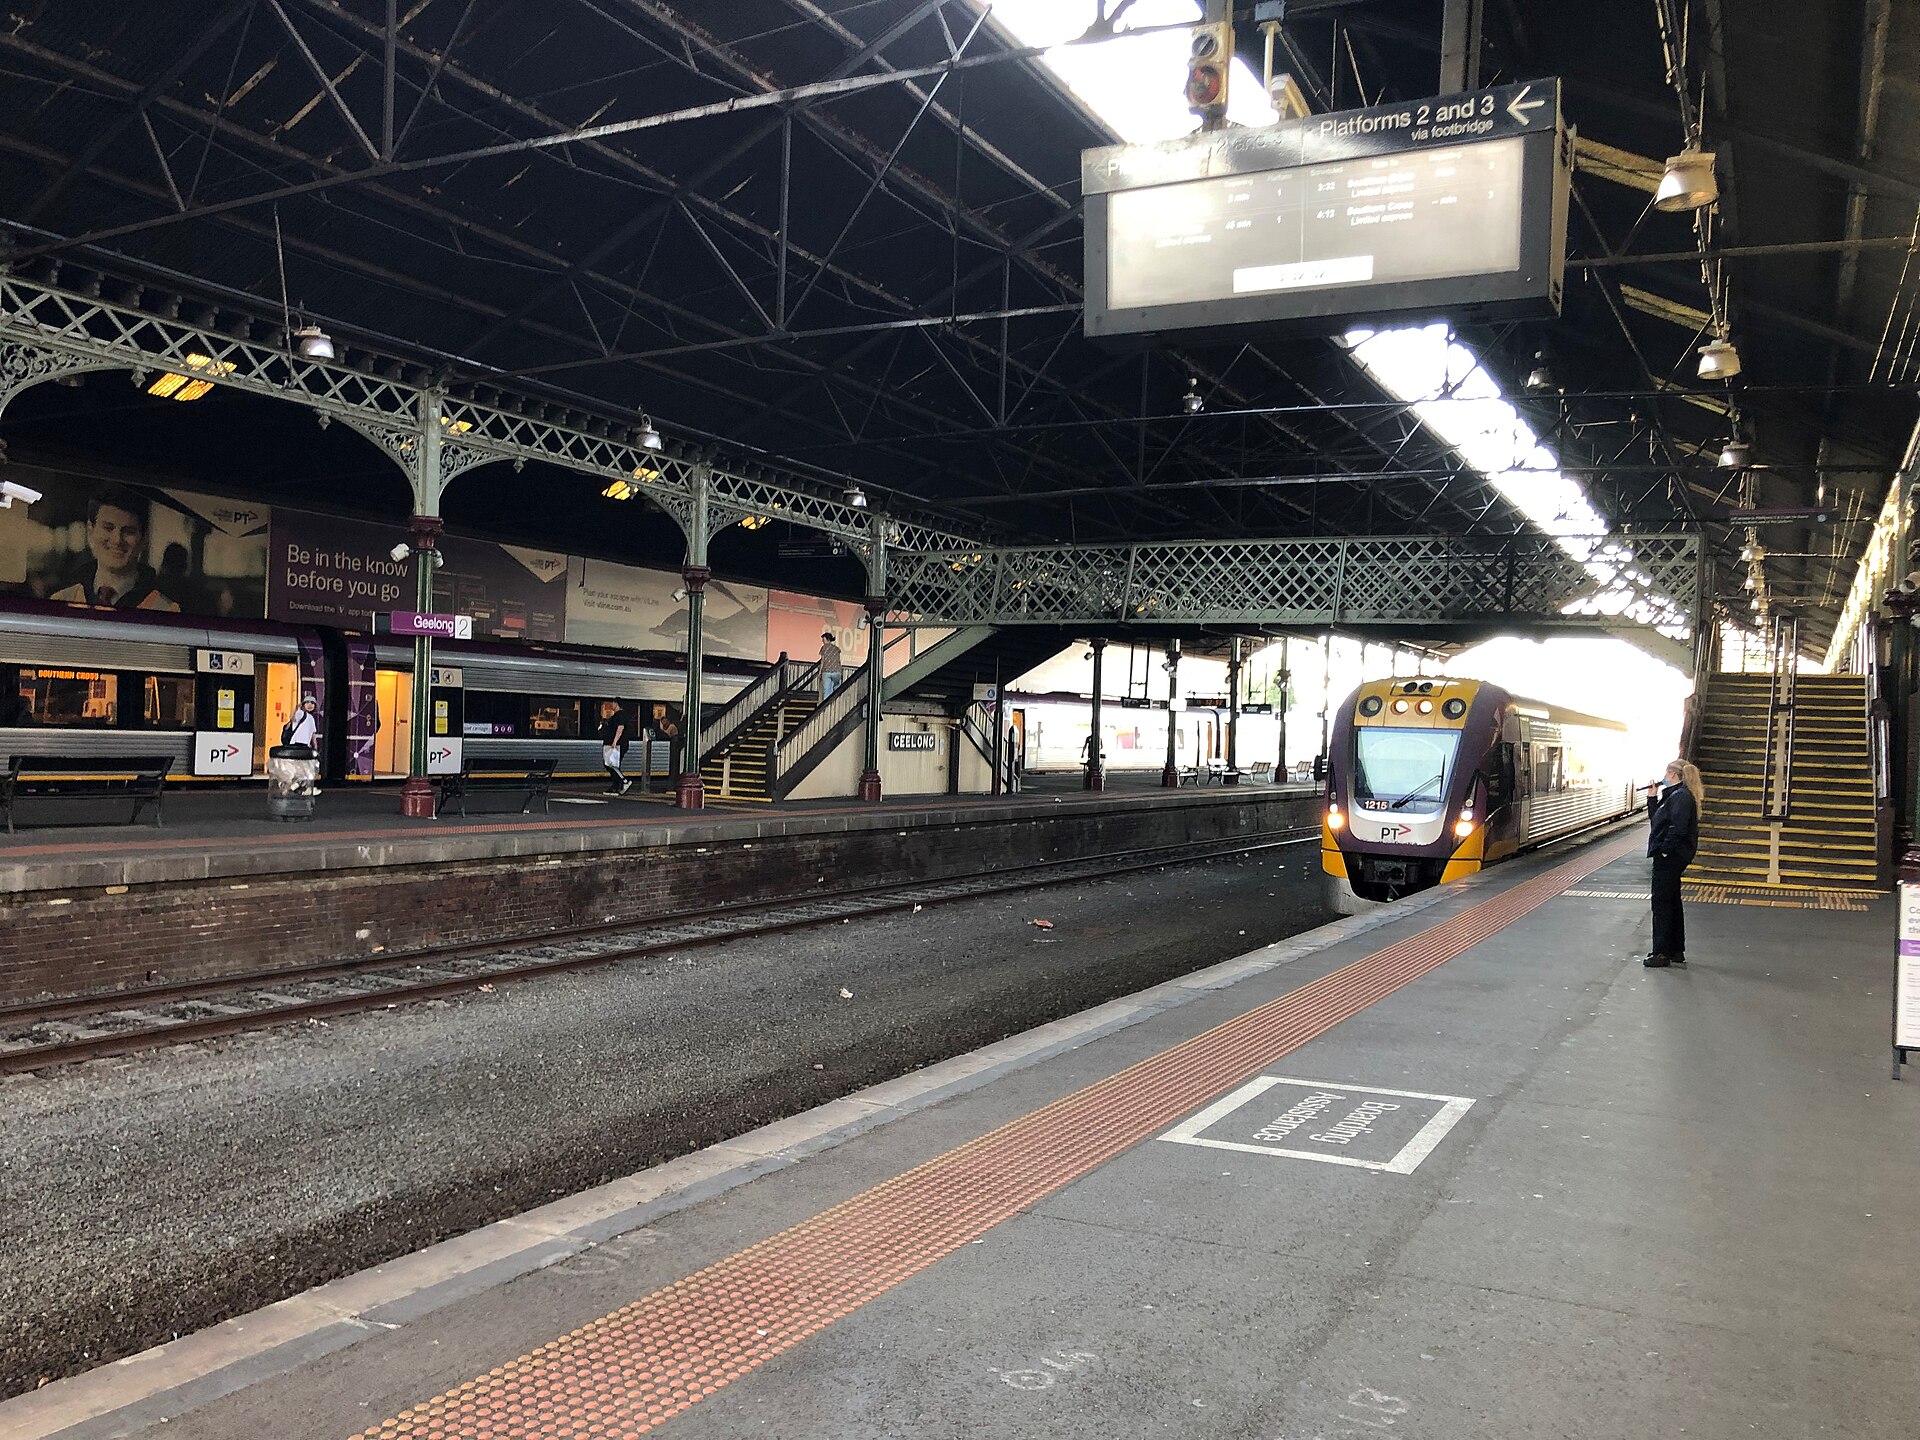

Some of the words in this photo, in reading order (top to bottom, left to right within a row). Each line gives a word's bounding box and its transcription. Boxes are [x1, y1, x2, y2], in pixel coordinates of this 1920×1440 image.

[1320, 111, 1412, 138] Platforms
[1416, 105, 1430, 125] 2
[1436, 98, 1475, 124] and
[1480, 95, 1495, 115] 3
[1411, 130, 1429, 141] via
[1432, 118, 1495, 140] footbridge
[287, 544, 311, 565] Be
[315, 547, 330, 567] in
[334, 551, 362, 572] the
[366, 555, 409, 578] know
[287, 568, 343, 592] before
[347, 581, 377, 598] you
[381, 583, 400, 602] go
[289, 601, 323, 614] Download
[324, 604, 336, 613] the
[413, 615, 454, 634] Geelong
[458, 618, 469, 637] 2
[893, 735, 934, 749] GEELONG
[1364, 800, 1389, 810] 1215
[1252, 1091, 1347, 1142] Assistance
[1309, 1101, 1400, 1145] Boarding
